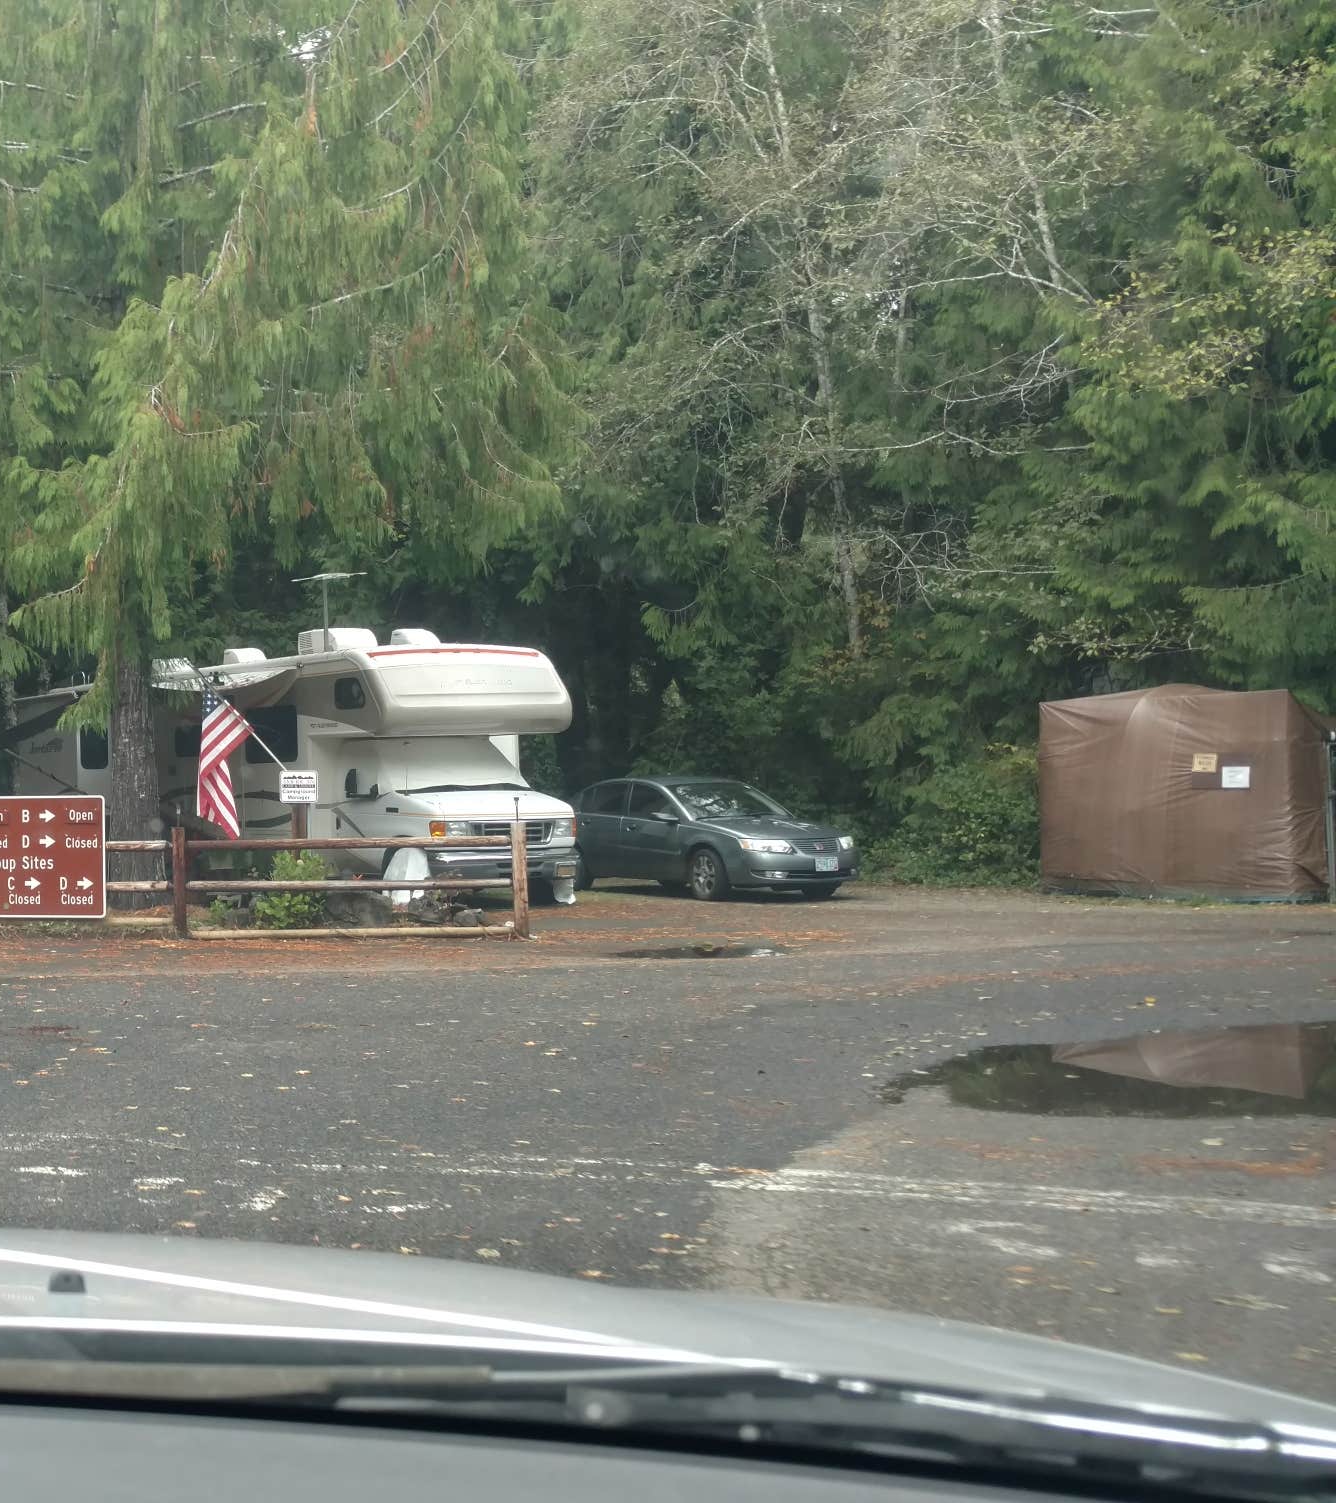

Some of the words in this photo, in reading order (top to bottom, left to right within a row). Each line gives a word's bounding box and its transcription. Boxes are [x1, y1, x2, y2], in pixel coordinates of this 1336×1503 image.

[22, 810, 30, 823] B
[69, 810, 94, 822] Open
[22, 836, 30, 848] D
[65, 837, 98, 848] Closed
[22, 856, 54, 870] Sites
[7, 877, 15, 890] C
[59, 877, 68, 890] D
[8, 893, 41, 905] Closed
[61, 893, 94, 905] Closed
